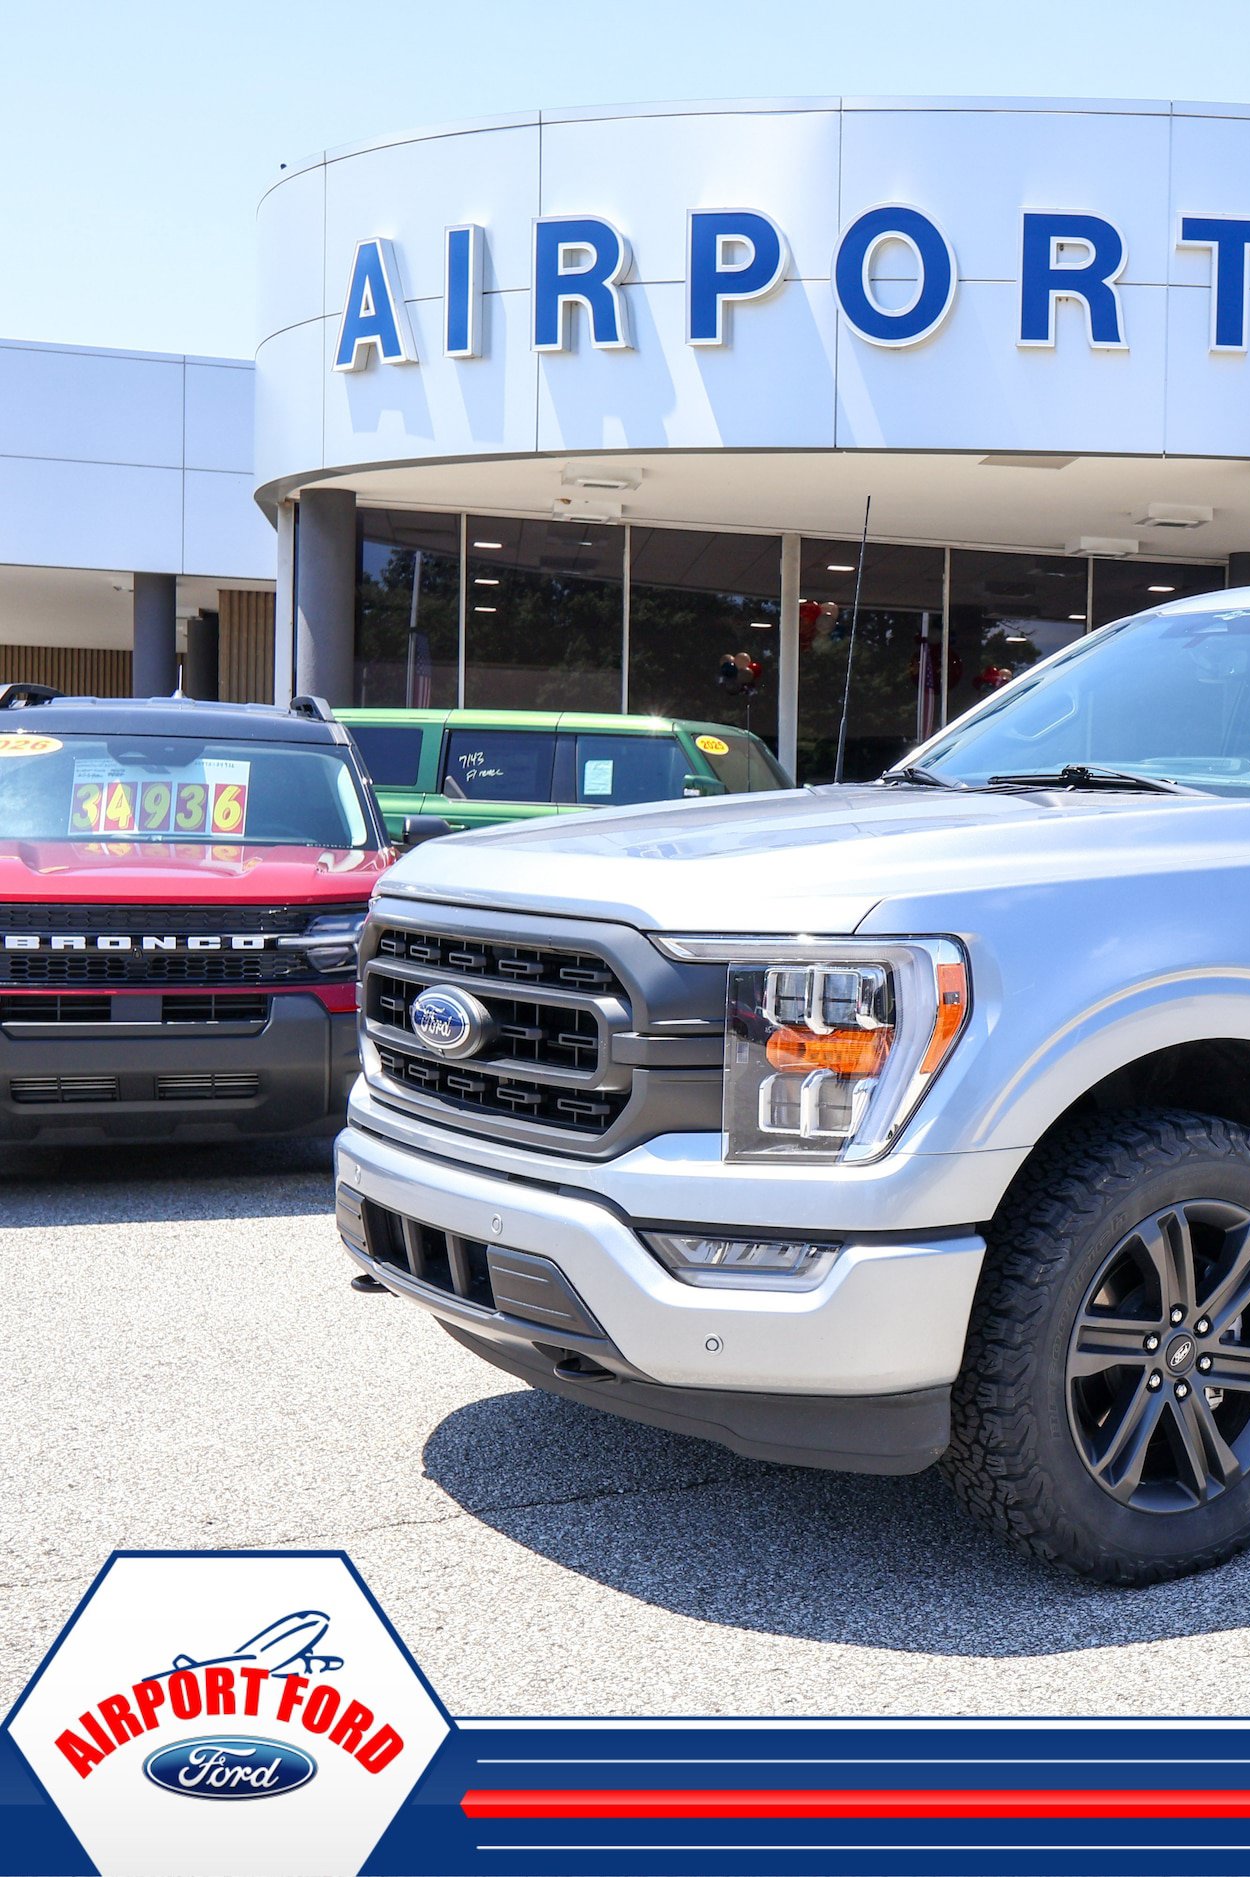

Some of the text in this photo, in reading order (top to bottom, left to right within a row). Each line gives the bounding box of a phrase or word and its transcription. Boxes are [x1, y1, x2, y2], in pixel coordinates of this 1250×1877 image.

[700, 740, 725, 750] 2025
[70, 783, 246, 832] 34936
[4, 935, 265, 949] BRONCO
[420, 1004, 453, 1037] Ford
